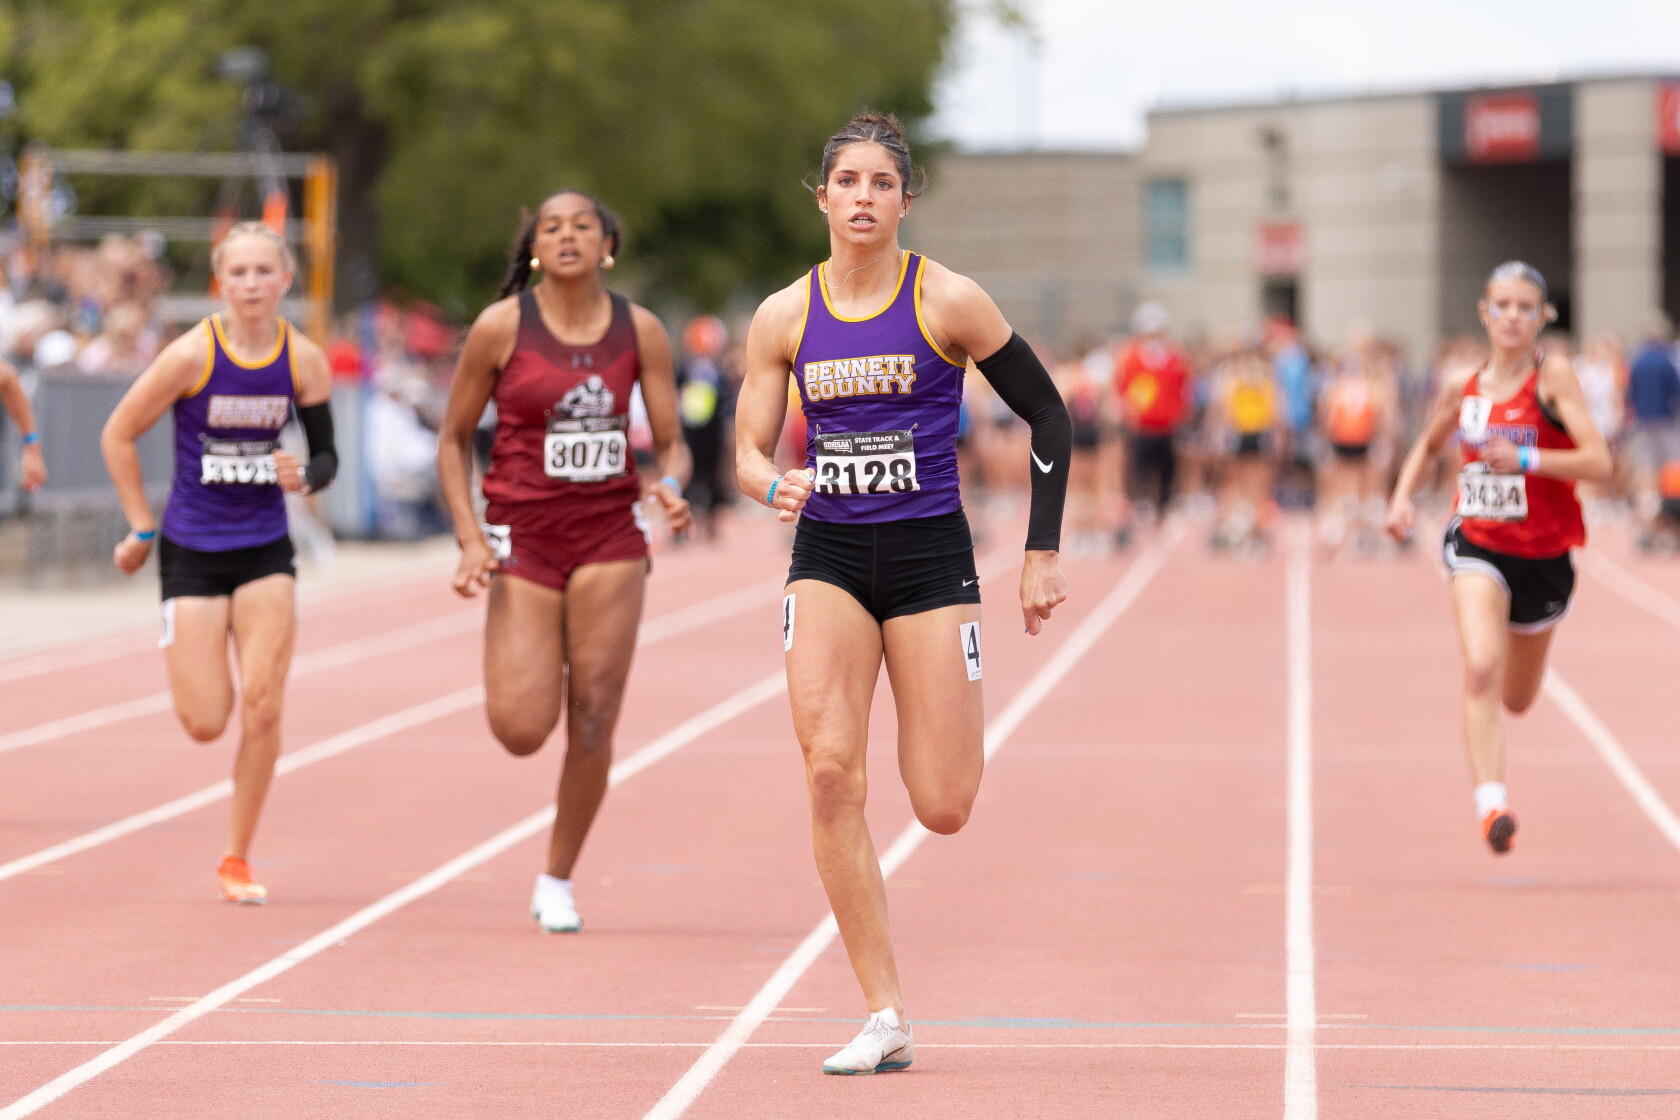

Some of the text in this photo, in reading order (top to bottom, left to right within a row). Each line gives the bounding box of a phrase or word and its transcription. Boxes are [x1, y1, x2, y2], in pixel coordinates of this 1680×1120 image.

[804, 355, 916, 384] BENNETT
[806, 374, 917, 402] COUNTY
[552, 439, 620, 468] 3079
[872, 435, 893, 443] TRACK
[819, 458, 914, 495] 3128
[967, 624, 980, 668] 4
